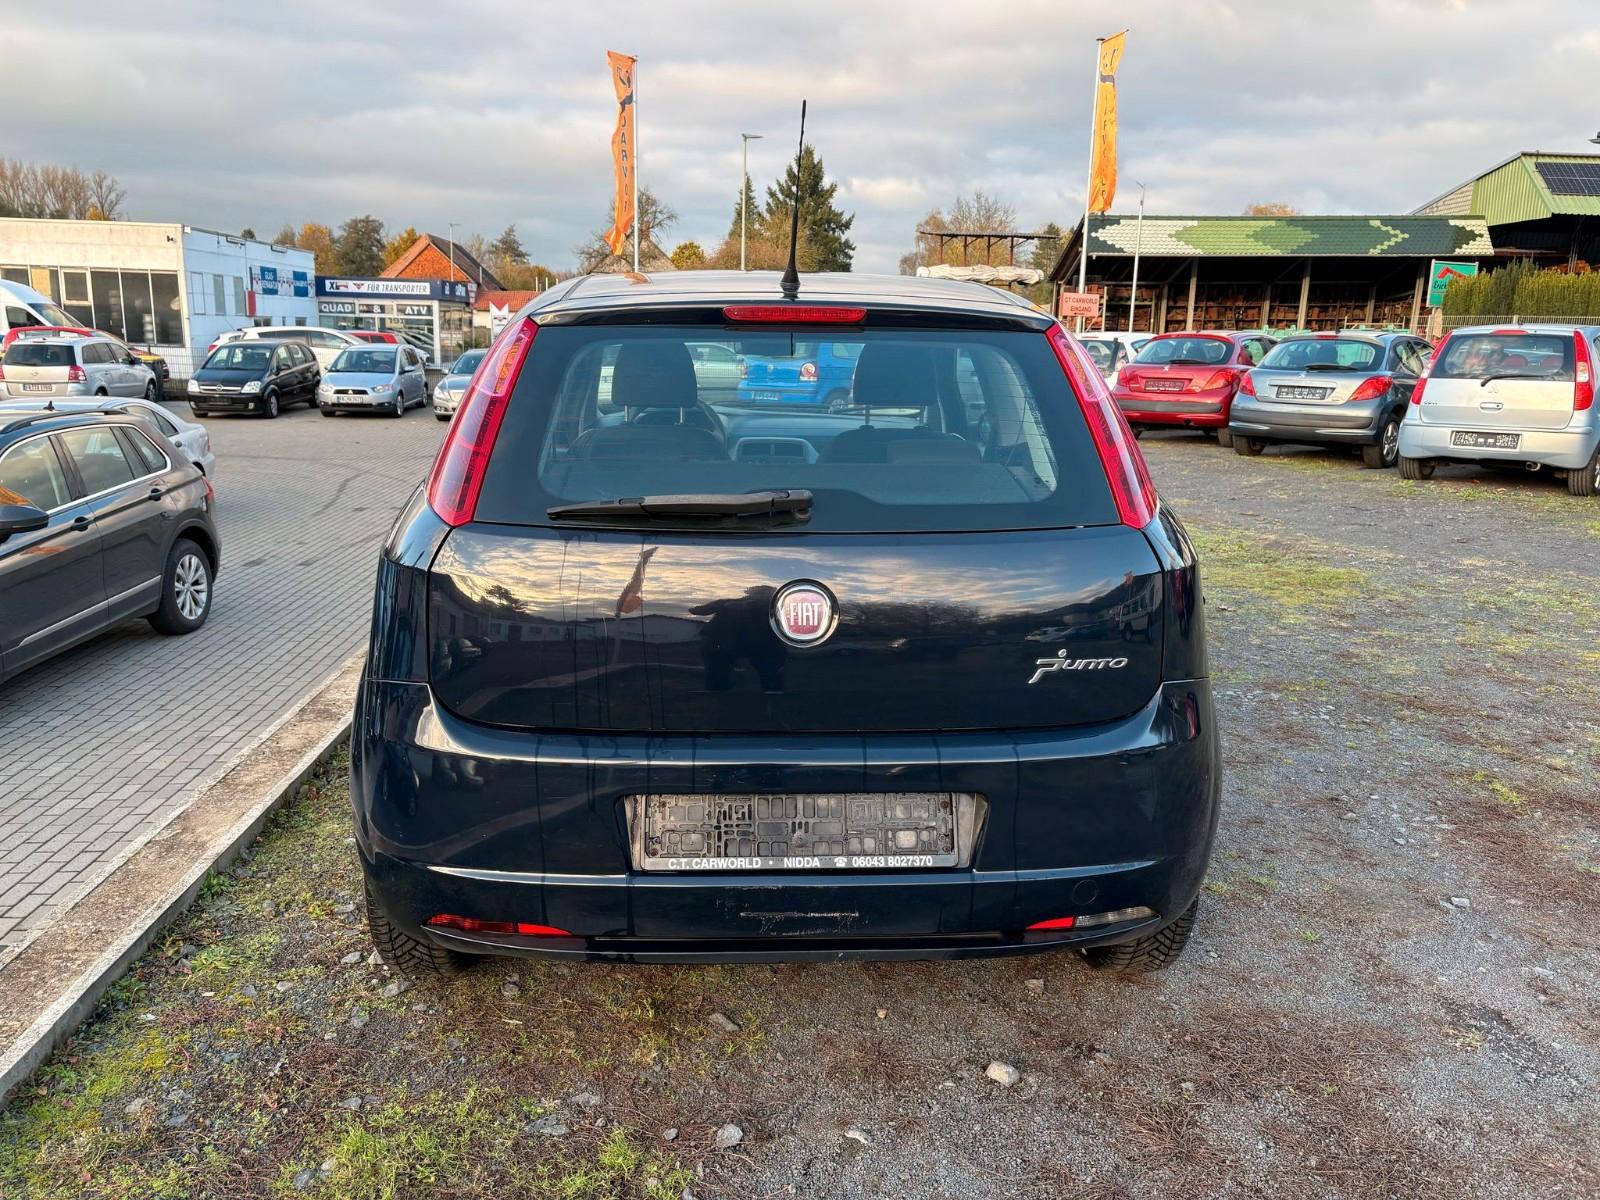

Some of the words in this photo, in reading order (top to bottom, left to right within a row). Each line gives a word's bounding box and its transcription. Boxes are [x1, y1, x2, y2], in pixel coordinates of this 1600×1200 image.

[367, 282, 381, 292] FÜR
[382, 283, 427, 293] TRANSPORTER
[321, 303, 352, 313] QUAD
[373, 305, 381, 313] &
[405, 306, 428, 315] ATV
[789, 602, 821, 626] FIAT
[668, 858, 690, 869] C.T.
[692, 858, 762, 869] CARWORLD
[783, 857, 820, 868] NIDDA
[852, 856, 885, 867] 06043
[887, 855, 933, 867] 8027370
